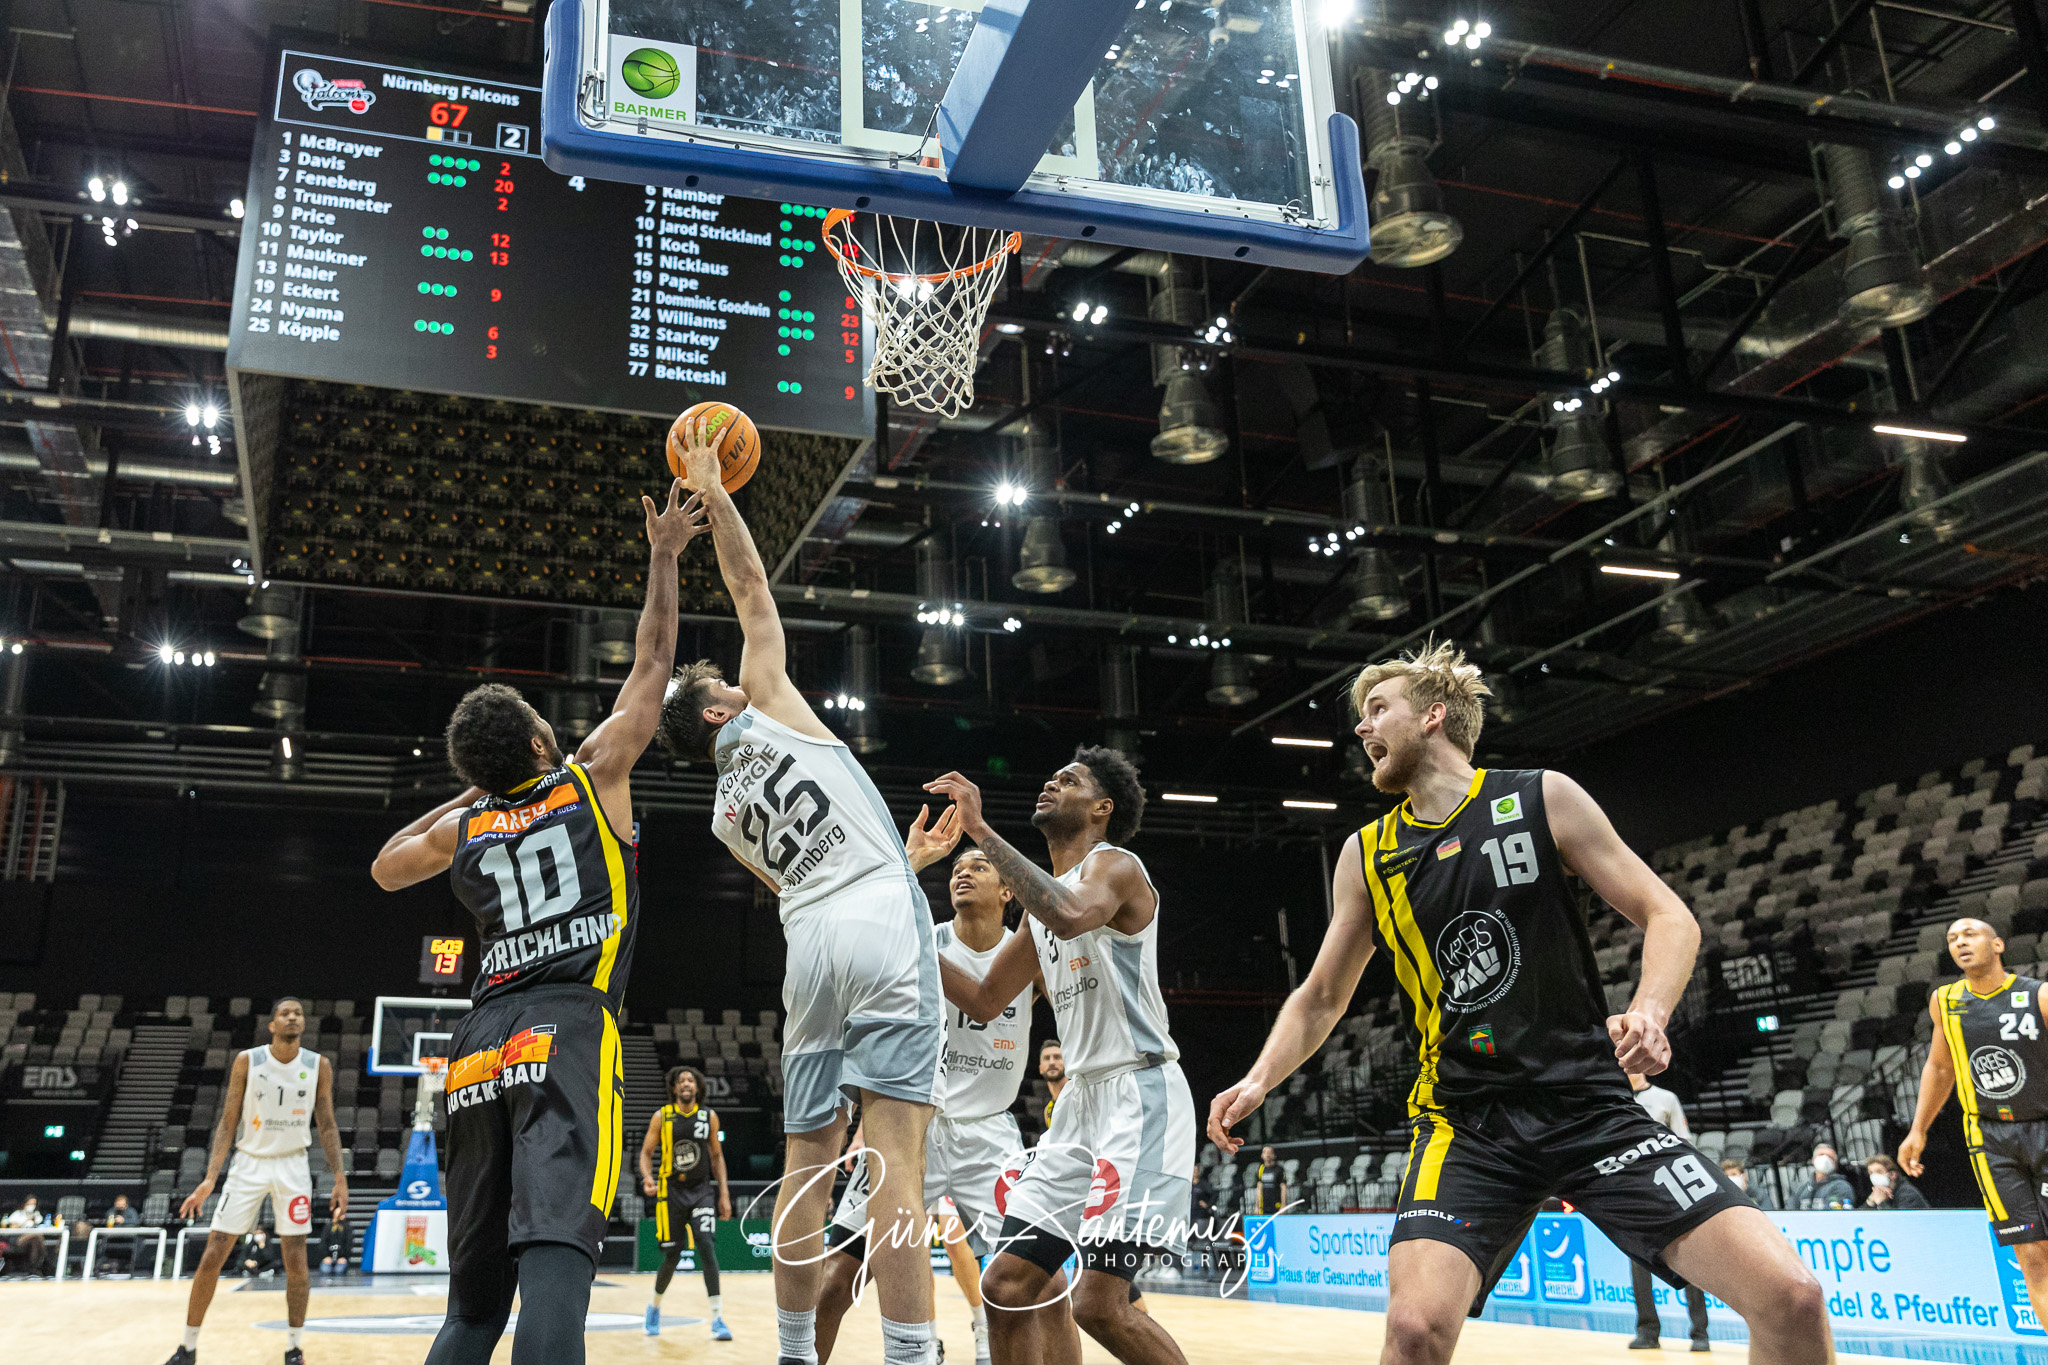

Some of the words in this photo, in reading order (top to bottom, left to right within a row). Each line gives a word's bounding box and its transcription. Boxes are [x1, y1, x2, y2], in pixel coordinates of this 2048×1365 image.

[382, 73, 458, 100] Nürnberg
[461, 85, 520, 107] Falcons
[430, 101, 469, 127] 67
[614, 101, 687, 121] BARMER
[503, 127, 521, 148] 2
[282, 131, 292, 146] 1
[299, 133, 383, 158] McBrayer
[500, 162, 511, 175] 2
[278, 149, 291, 163] 3
[297, 152, 346, 171] Davis
[494, 179, 515, 194] 20
[568, 175, 587, 192] 4
[274, 186, 287, 200] 8
[293, 187, 393, 215] Trummeter
[277, 167, 289, 181] 7
[295, 169, 377, 197] Feneberg
[497, 198, 509, 211] 2
[645, 184, 657, 197] 6
[662, 186, 726, 206] Kamber
[272, 204, 285, 218] 9
[291, 206, 336, 226] Price
[644, 199, 657, 213] 7
[661, 201, 720, 222] Fischer
[261, 221, 282, 237] 10
[289, 224, 345, 246] Taylor
[491, 233, 511, 249] 12
[635, 215, 655, 231] 10
[658, 218, 698, 238] Jarod
[699, 224, 772, 247] Strickland
[259, 240, 279, 256] 11
[286, 243, 368, 267] Maukner
[490, 251, 509, 266] 13
[634, 234, 653, 249] 11
[660, 236, 700, 256] Koch
[256, 259, 277, 275] 13
[633, 251, 653, 267] 15
[659, 254, 730, 277] Nicklaus
[254, 278, 276, 294] 19
[282, 281, 340, 302] Eckert
[490, 288, 502, 303] 9
[632, 269, 653, 285] 19
[658, 272, 700, 292] Pape
[250, 297, 273, 313] 24
[280, 300, 345, 323] Nyama
[631, 287, 651, 303] 21
[655, 290, 717, 312] Domminic
[717, 298, 772, 318] Goodwin
[845, 297, 856, 310] 8
[248, 317, 270, 333] 25
[277, 319, 341, 343] Köpple
[487, 326, 499, 340] 6
[630, 305, 651, 321] 24
[657, 308, 728, 331] Williams
[841, 313, 860, 328] 23
[629, 323, 650, 340] 32
[656, 327, 720, 351] Starkey
[841, 332, 860, 347] 12
[486, 344, 498, 360] 3
[628, 342, 650, 358] 55
[655, 345, 709, 366] Miksic
[845, 349, 856, 363] 5
[628, 361, 649, 377] 77
[654, 364, 727, 386] Bekteshi
[844, 385, 856, 400] 9
[741, 753, 831, 877] 25
[1495, 812, 1520, 822] BARMER
[1480, 831, 1540, 888] 19
[478, 823, 582, 932] 10
[430, 939, 464, 955] 6:03
[1441, 918, 1492, 967] KREIS
[434, 953, 458, 974] 13
[1069, 955, 1091, 972] EMS
[1449, 946, 1501, 1000] BAU
[1998, 1012, 2040, 1041] 24
[993, 1038, 1016, 1050] EMS
[947, 1050, 1014, 1071] filmstudio
[1971, 1050, 2009, 1075] KREIS
[22, 1065, 79, 1089] EMS
[1979, 1066, 2017, 1091] BAU
[277, 1085, 283, 1106] 1
[693, 1121, 710, 1140] 21
[1593, 1133, 1683, 1176] Bona
[1653, 1154, 1719, 1211] 19
[700, 1215, 716, 1233] 21
[1398, 1208, 1455, 1222] MOSOLF
[1279, 1265, 1302, 1284] Haus
[1304, 1266, 1321, 1284] der
[1322, 1266, 1382, 1288] Gesundheit
[1593, 1278, 1636, 1304] Haus
[1652, 1287, 1670, 1305] er
[1826, 1291, 1864, 1318] del
[1870, 1292, 1890, 1320] &
[1893, 1293, 1999, 1327] Pfeuffer
